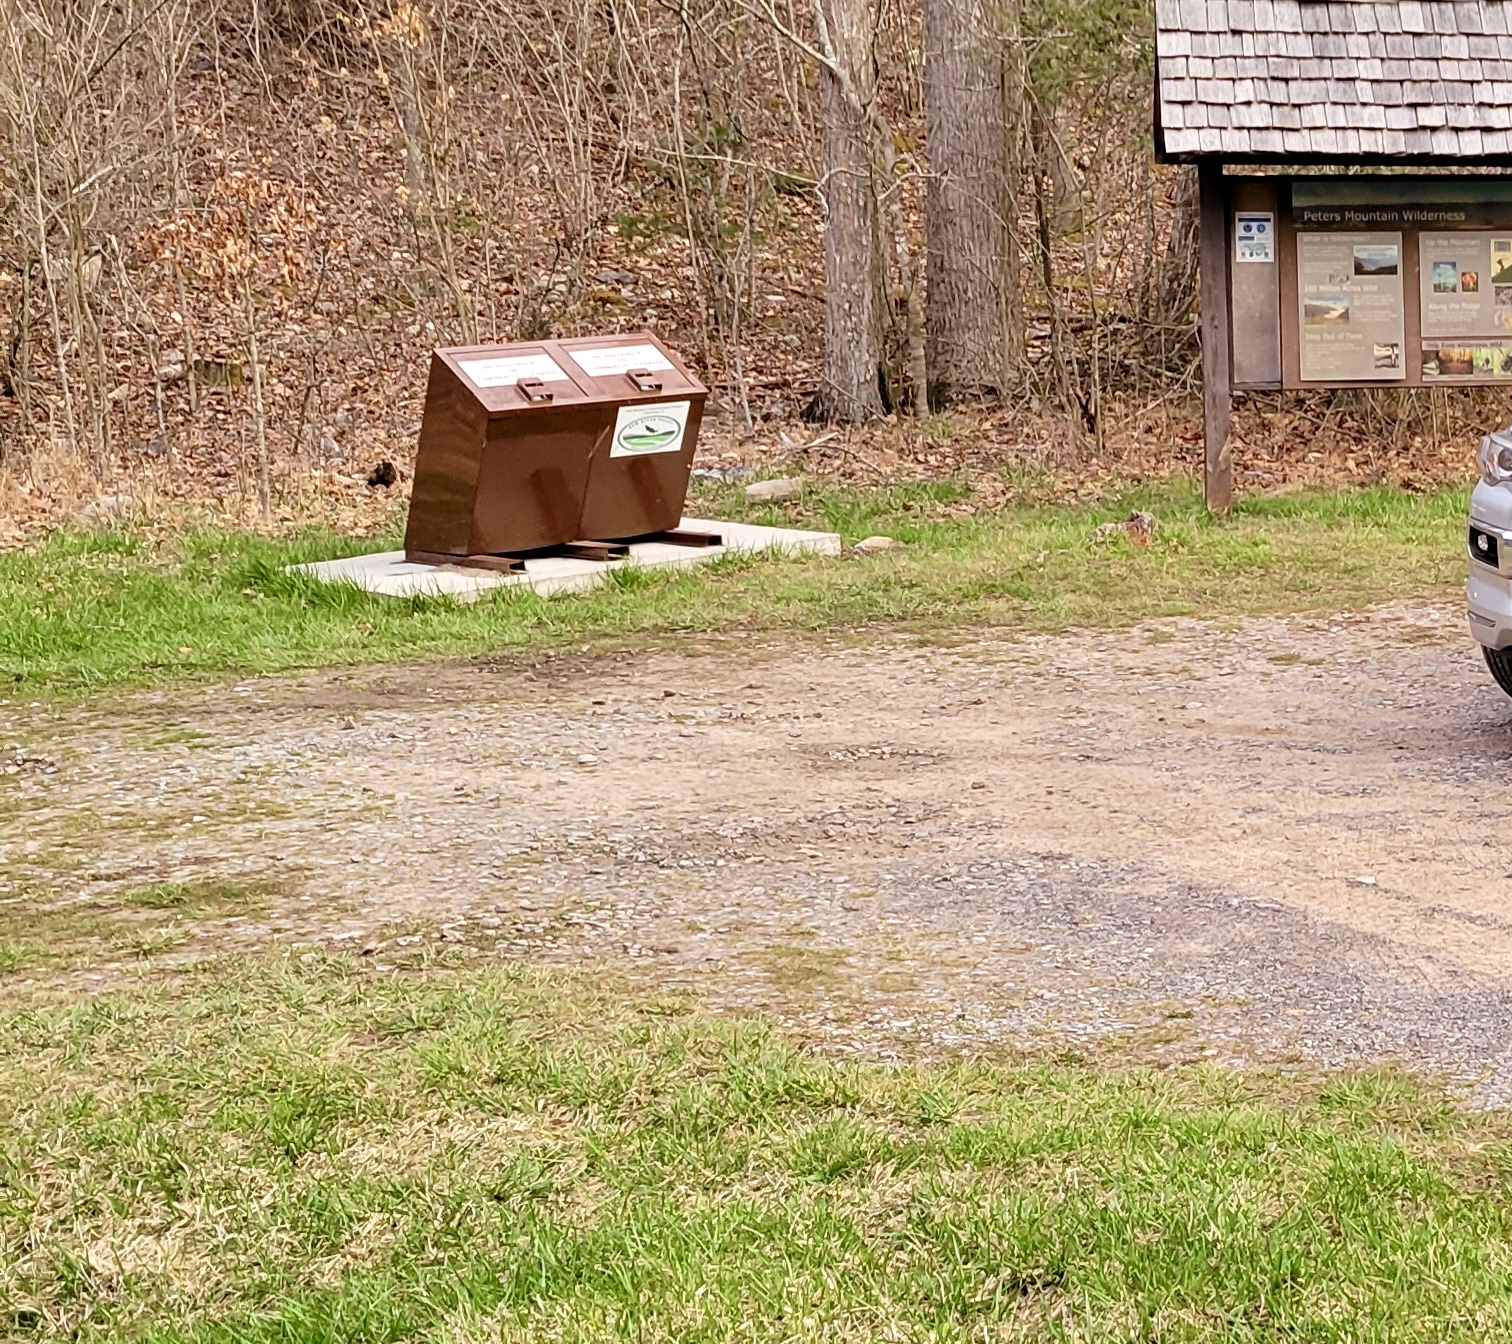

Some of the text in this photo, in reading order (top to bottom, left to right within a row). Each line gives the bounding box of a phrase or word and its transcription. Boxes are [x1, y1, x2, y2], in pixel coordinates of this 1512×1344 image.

[1303, 209, 1466, 222] Peters Mountain Wilderness
